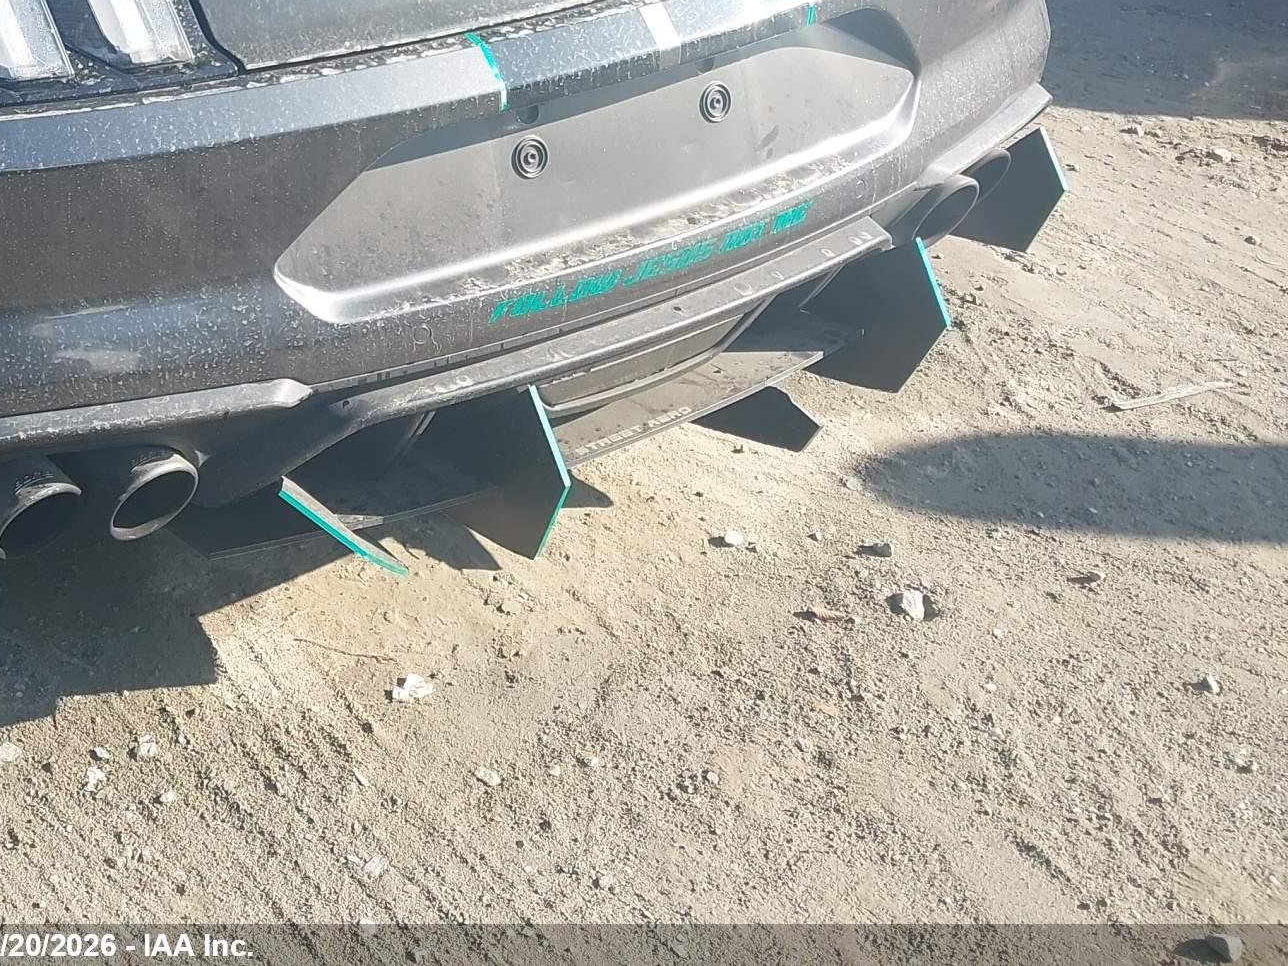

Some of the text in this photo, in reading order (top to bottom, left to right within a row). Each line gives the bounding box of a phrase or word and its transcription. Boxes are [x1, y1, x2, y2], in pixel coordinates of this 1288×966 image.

[488, 267, 622, 324] FOLLOW
[574, 406, 693, 456] STREET AERO
